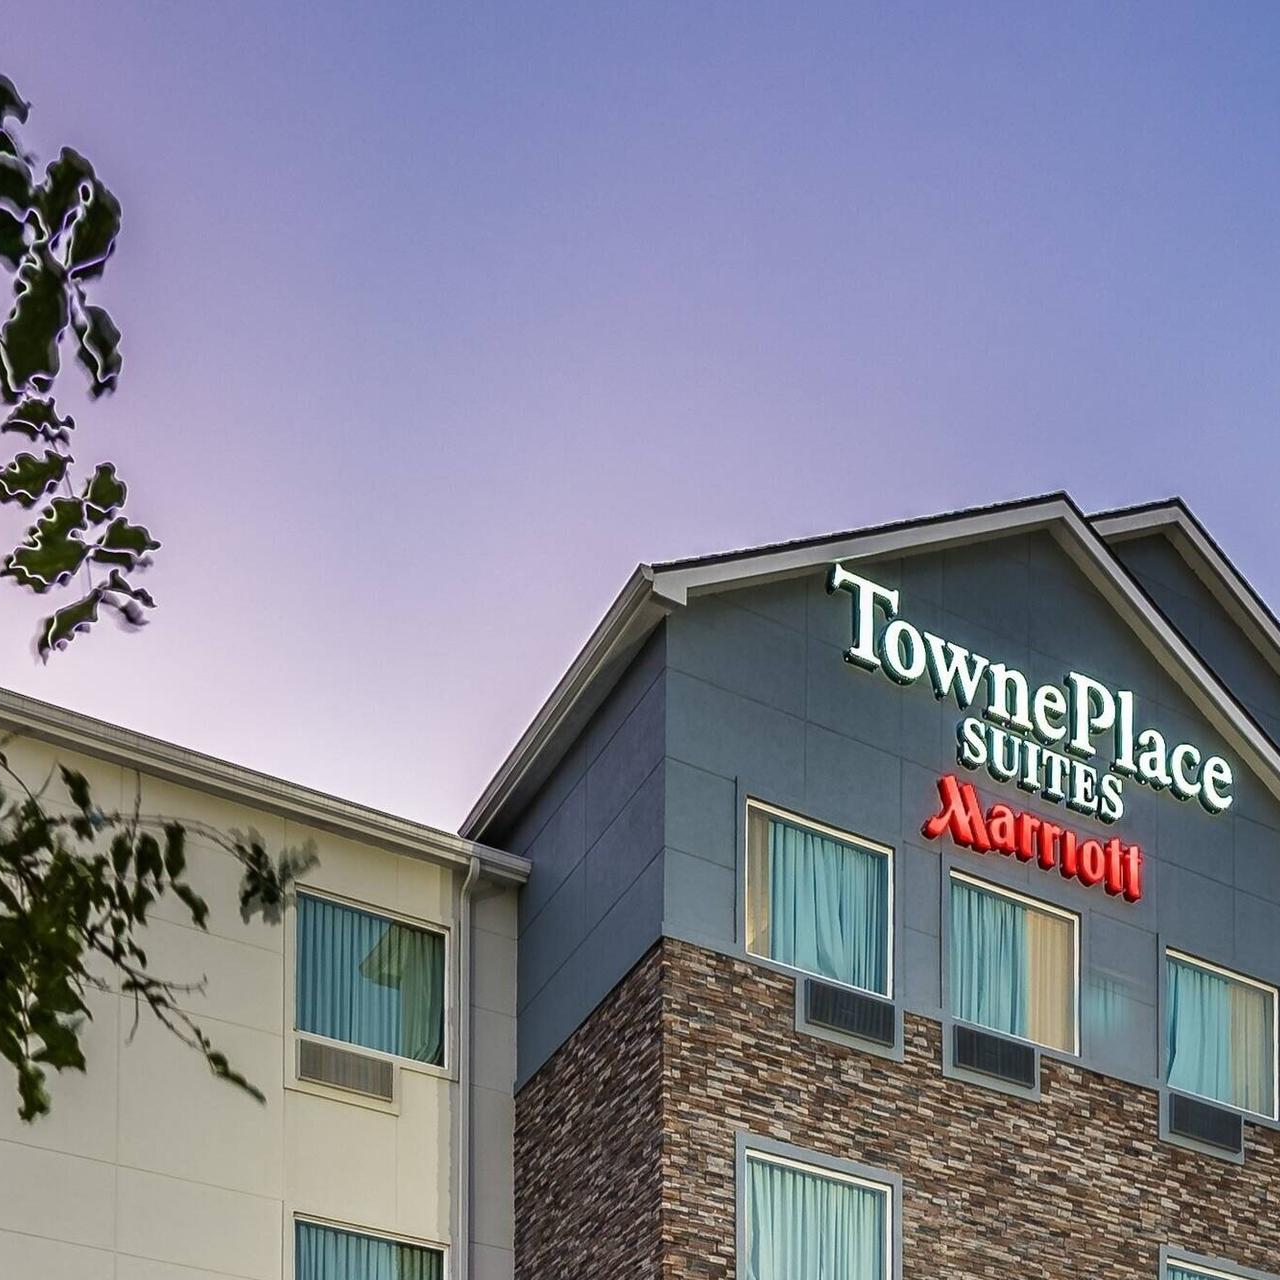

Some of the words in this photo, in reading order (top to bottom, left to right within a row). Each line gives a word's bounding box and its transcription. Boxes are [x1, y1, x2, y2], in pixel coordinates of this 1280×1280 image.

[826, 562, 1234, 815] TownePlace
[957, 716, 1125, 823] SUITES
[921, 774, 1144, 902] Marriott
